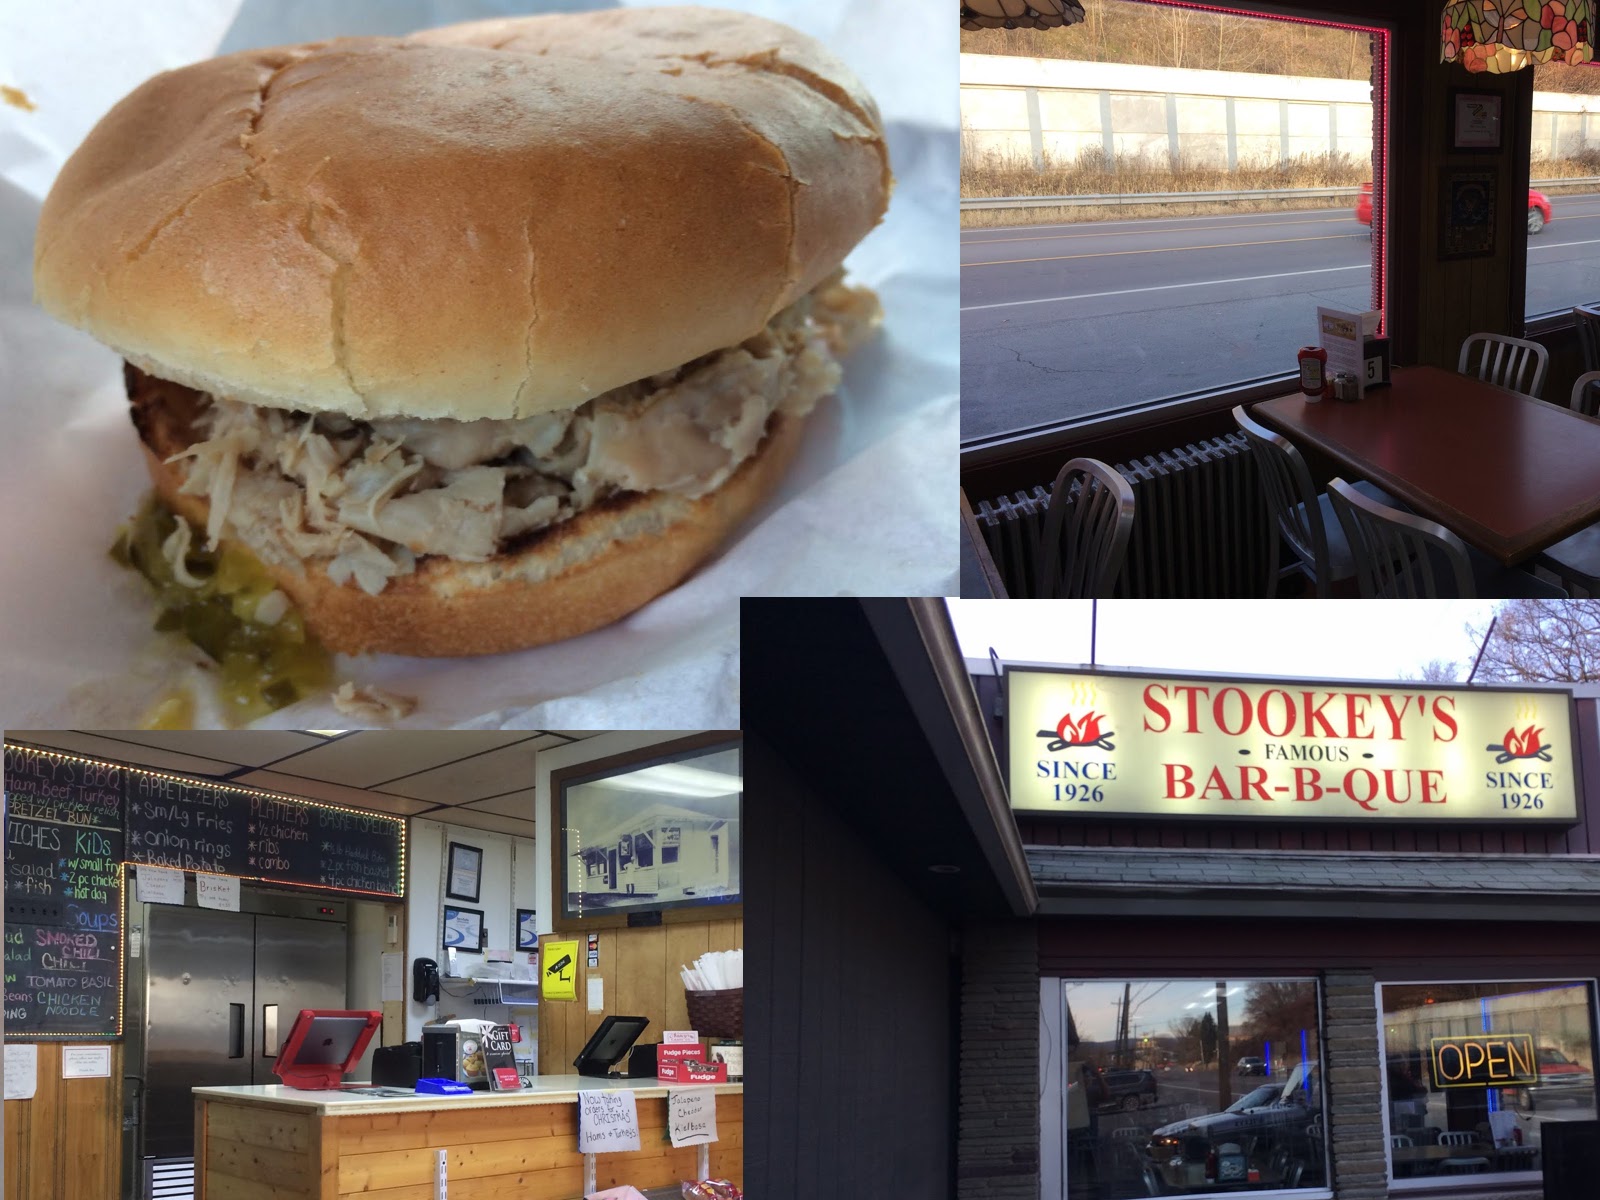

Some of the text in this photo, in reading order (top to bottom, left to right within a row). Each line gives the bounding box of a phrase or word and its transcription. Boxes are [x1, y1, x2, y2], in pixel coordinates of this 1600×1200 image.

[1367, 361, 1375, 379] 5
[1142, 683, 1458, 743] STOOKEY'S
[1265, 743, 1350, 763] FAMOUS
[83, 763, 120, 791] BBQ
[1036, 760, 1117, 781] SINCE
[1162, 763, 1448, 811] BAR-B-QUE
[1485, 770, 1554, 791] SINCE
[76, 785, 120, 809] Turkey
[1052, 782, 1104, 803] 1926
[1500, 792, 1545, 810] 1926
[250, 796, 309, 827] PLATTERS
[196, 811, 233, 834] Fries
[270, 826, 309, 841] chicken
[194, 839, 231, 859] rings
[258, 840, 280, 855] ribs
[147, 849, 181, 867] Baked
[185, 854, 226, 873] Potato
[258, 858, 290, 870] combo
[327, 860, 335, 871] 2
[25, 876, 52, 896] fish
[68, 871, 76, 884] 2
[78, 875, 89, 889] pc
[327, 873, 335, 886] 4
[346, 875, 375, 891] chicken
[74, 886, 107, 904] hot dog
[35, 928, 98, 948] SMOKED
[4, 945, 100, 961] alad CHILI
[26, 975, 77, 989] TOMATO
[81, 975, 114, 989] BASIL
[37, 991, 101, 1006] CHICKEN
[45, 1006, 99, 1017] NOODLE
[491, 1030, 509, 1041] GIFT
[490, 1041, 512, 1051] CARD
[663, 1049, 681, 1057] Fudge
[1438, 1040, 1532, 1080] OPEN
[661, 1068, 675, 1076] Fudge
[583, 1092, 602, 1105] Now
[584, 1105, 604, 1116] orders
[585, 1131, 606, 1143] Hams
